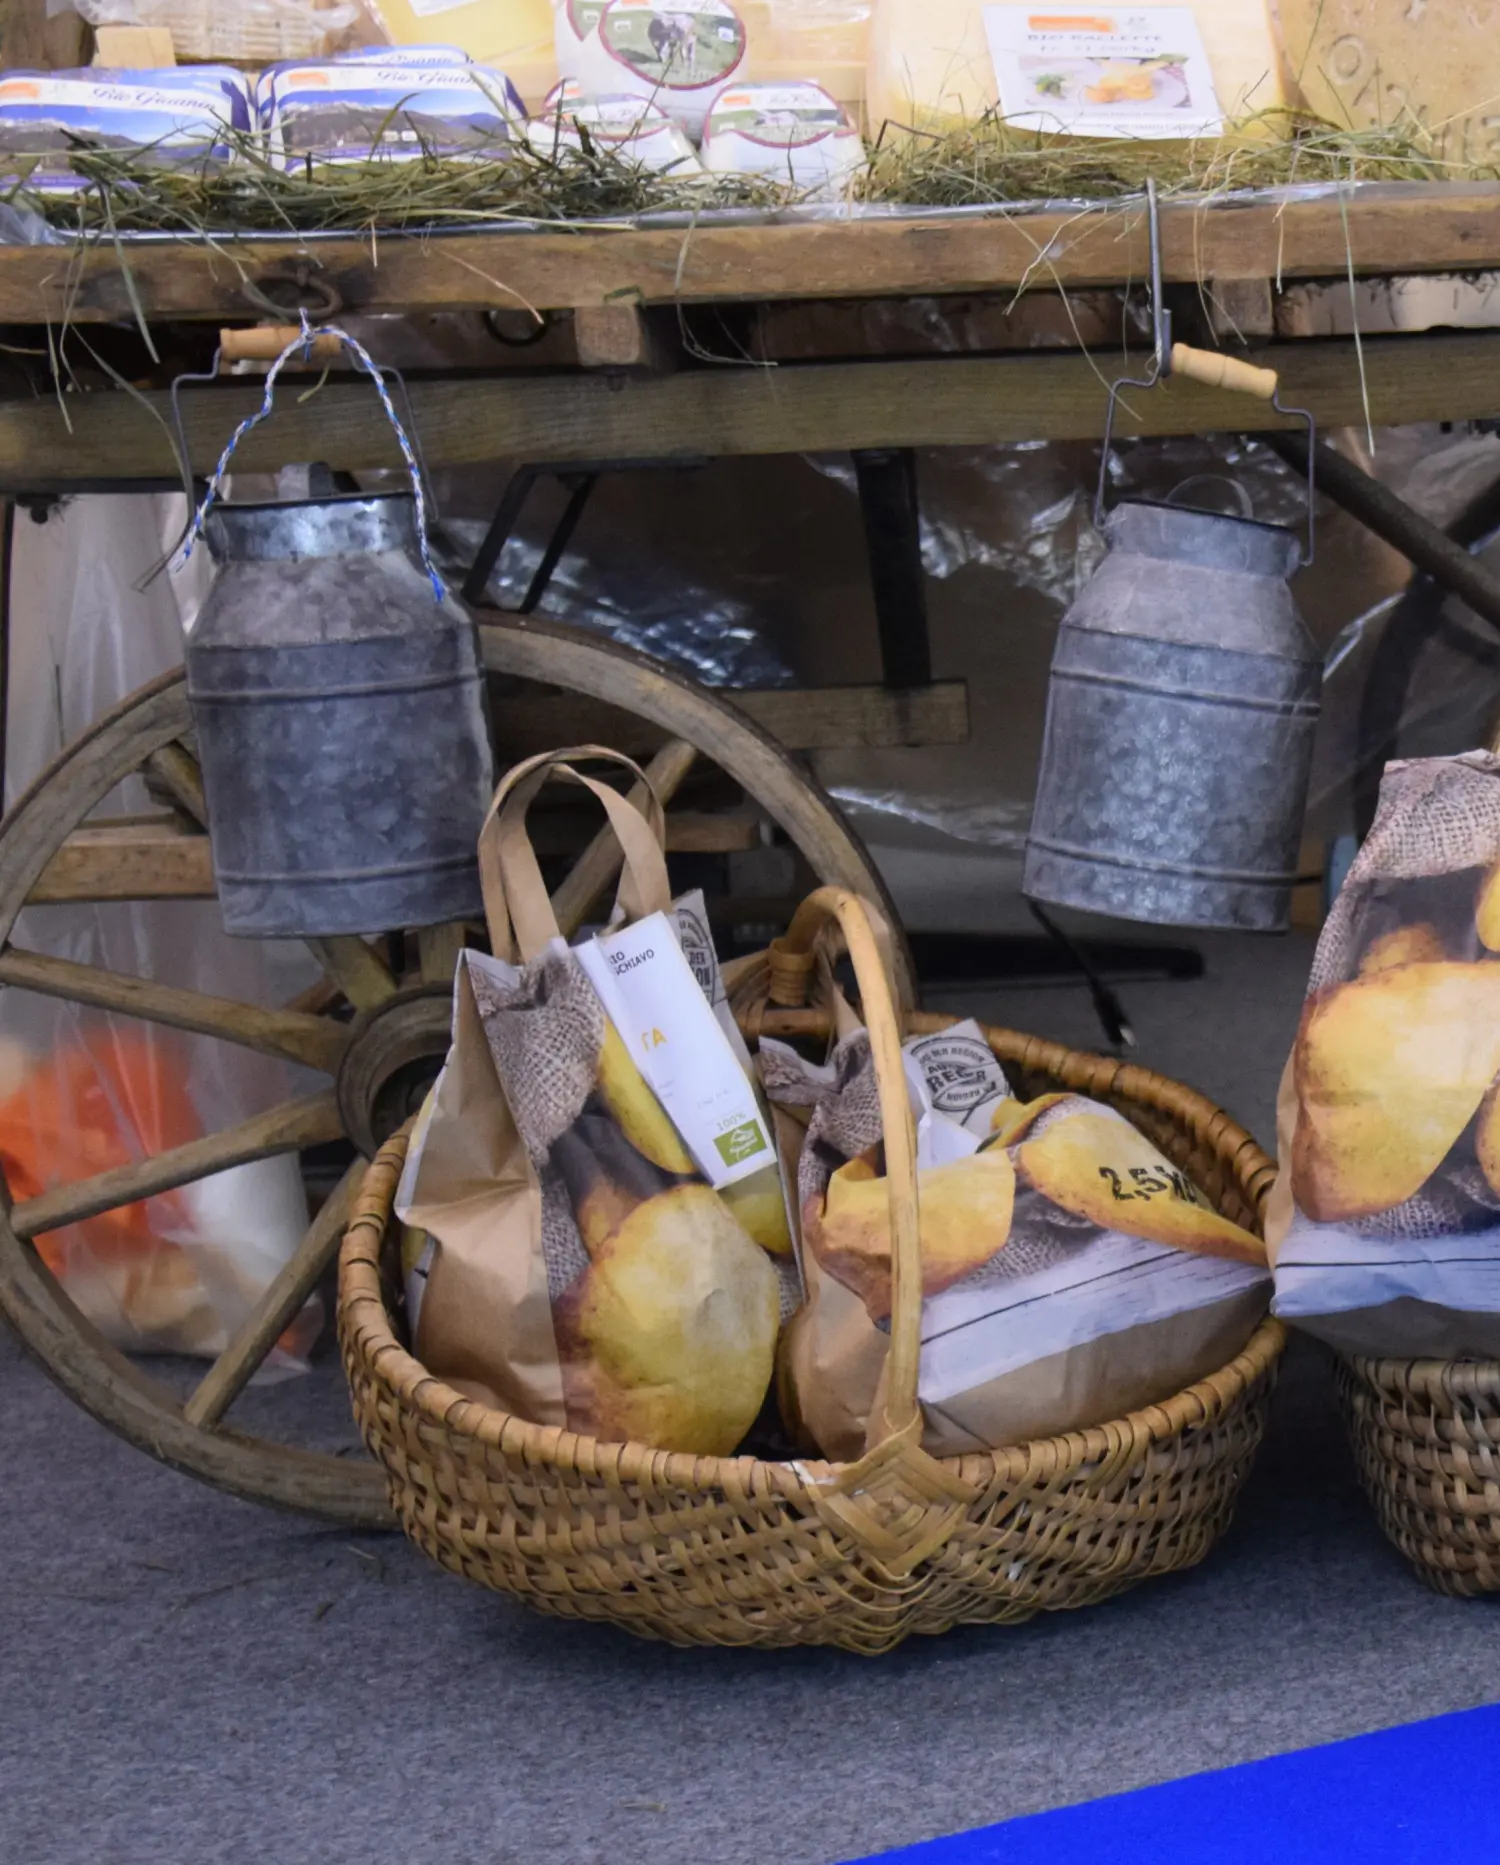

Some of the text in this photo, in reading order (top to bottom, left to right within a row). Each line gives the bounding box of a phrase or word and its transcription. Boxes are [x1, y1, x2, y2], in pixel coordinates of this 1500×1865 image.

[610, 950, 626, 966] IO
[716, 1111, 747, 1132] 100%
[1098, 1166, 1168, 1201] 2,5
